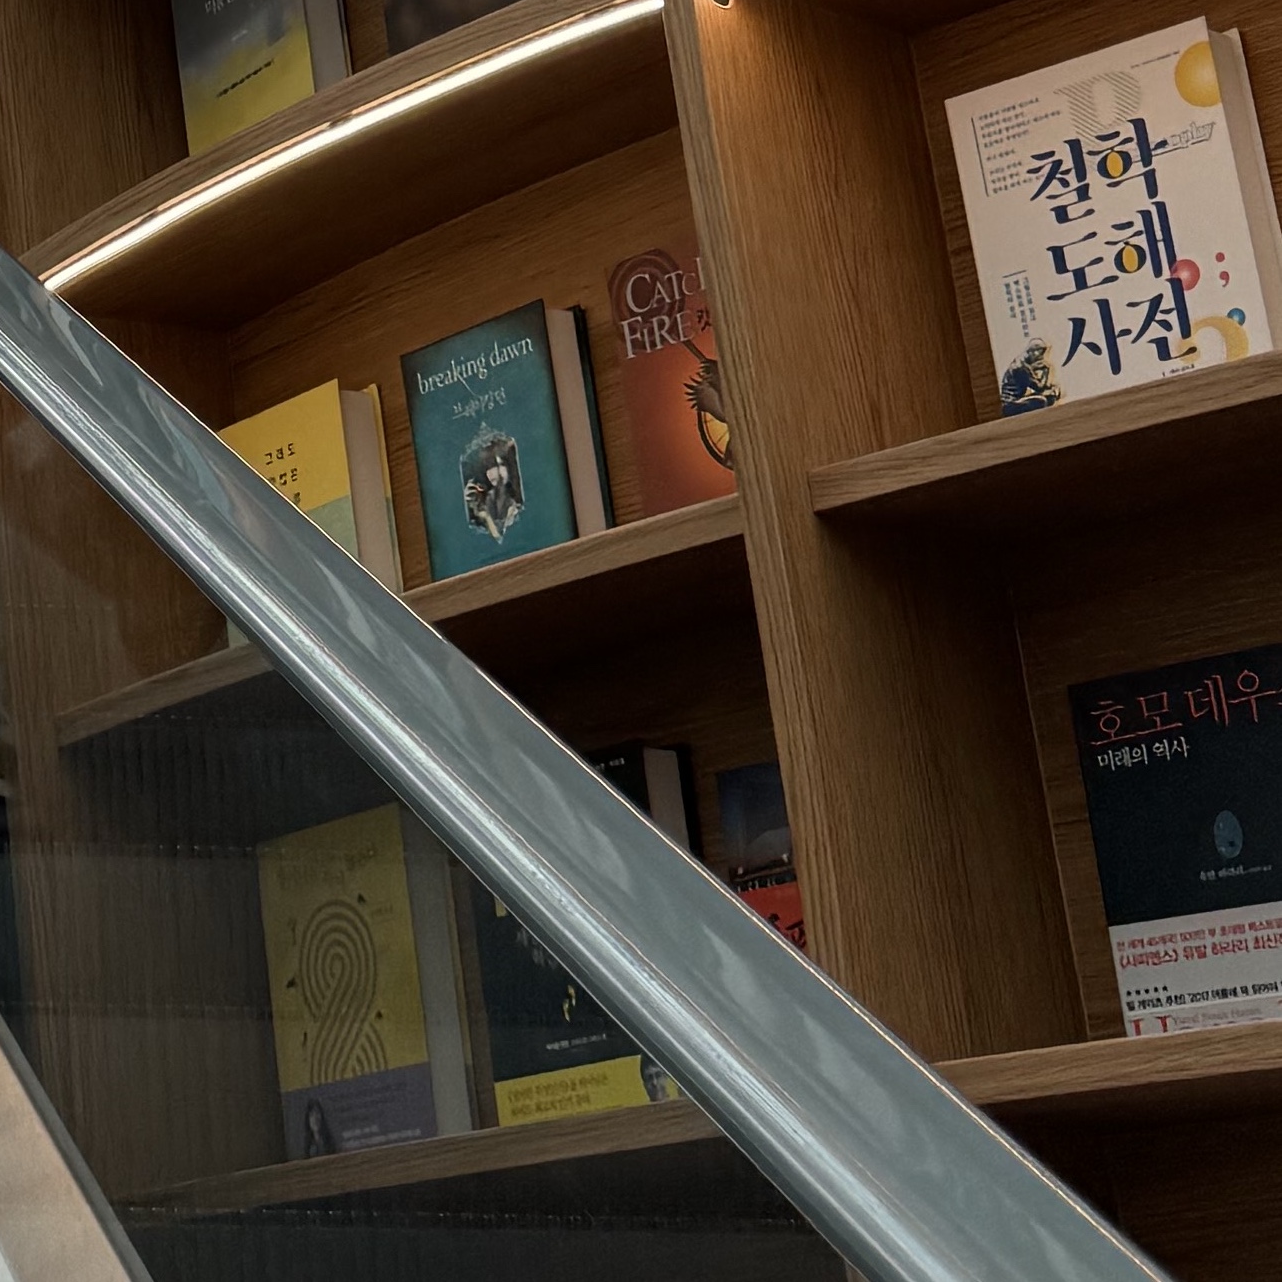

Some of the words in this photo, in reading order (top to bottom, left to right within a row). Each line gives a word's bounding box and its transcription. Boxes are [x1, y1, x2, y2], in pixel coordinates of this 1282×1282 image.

[1026, 118, 1169, 225] 철학
[1046, 201, 1176, 301] 도해
[620, 307, 696, 360] FIRE
[1061, 277, 1197, 376] 사전
[417, 355, 488, 397] breaking
[489, 335, 534, 378] dawn
[1090, 691, 1183, 745] 호모
[1185, 669, 1282, 727] 데우
[1098, 744, 1148, 773] 미래의
[1154, 736, 1189, 762] 역사
[1181, 944, 1207, 960] 유발
[1210, 937, 1249, 956] 하라리
